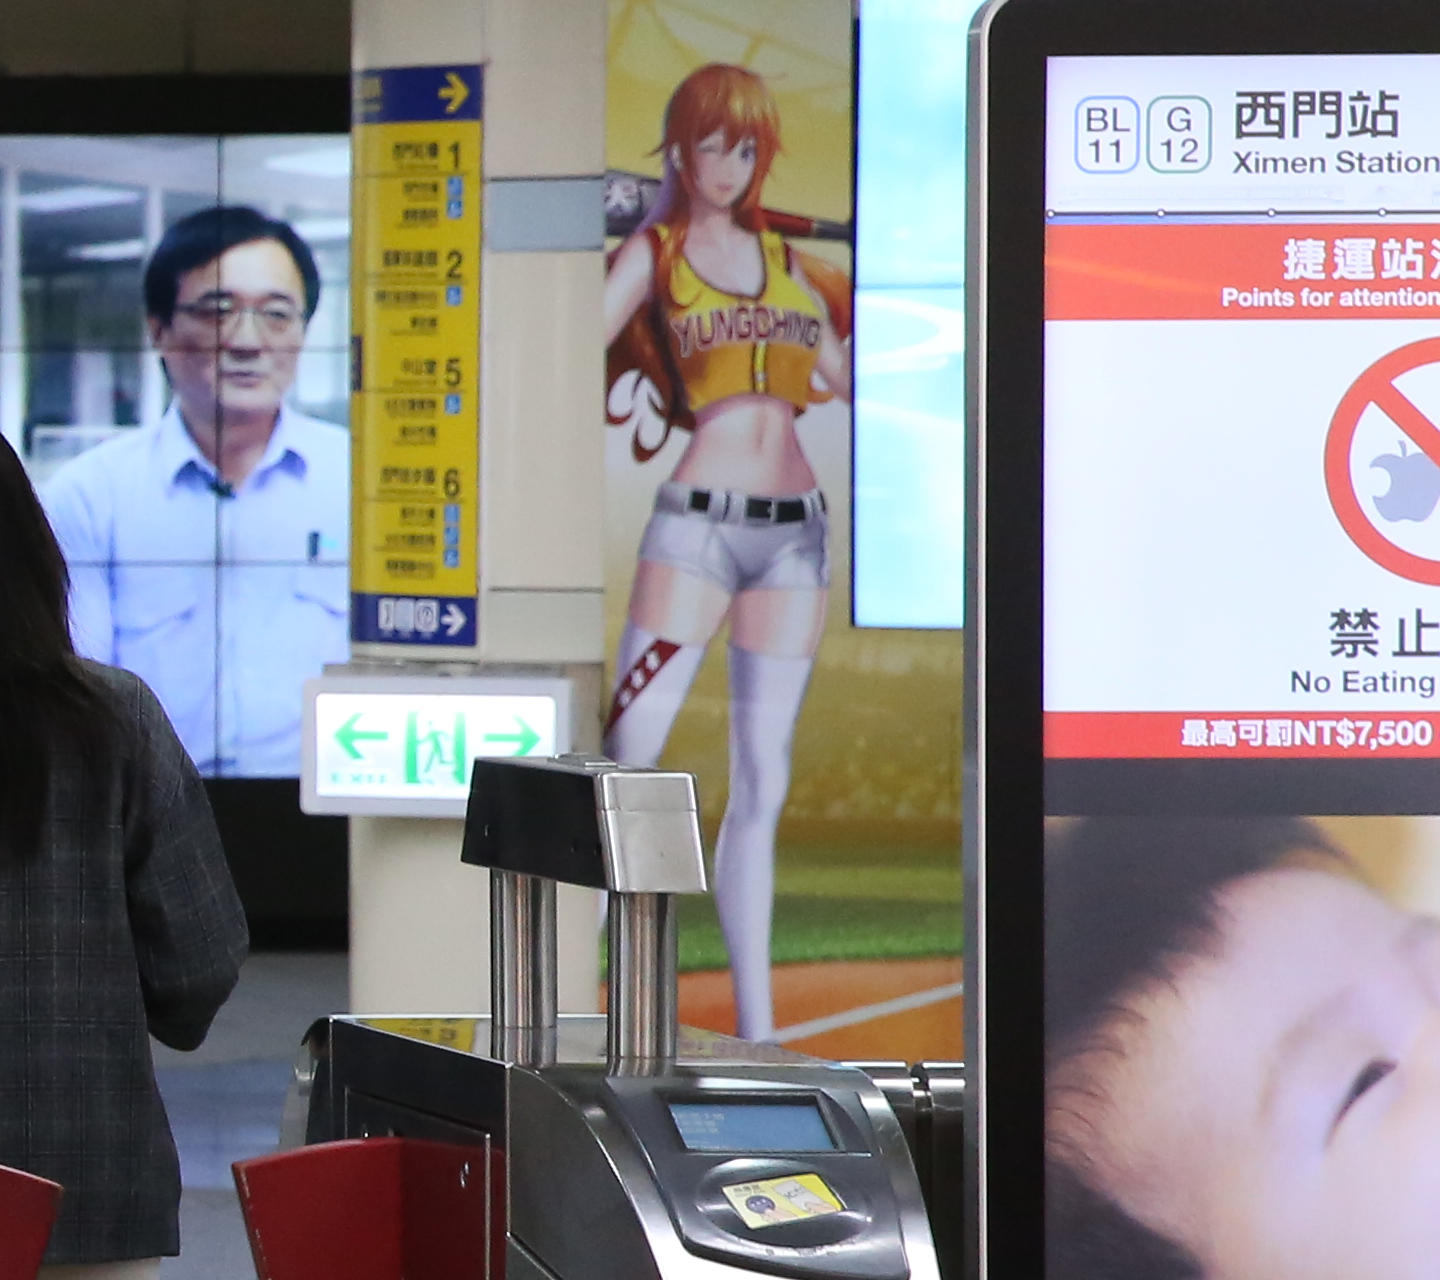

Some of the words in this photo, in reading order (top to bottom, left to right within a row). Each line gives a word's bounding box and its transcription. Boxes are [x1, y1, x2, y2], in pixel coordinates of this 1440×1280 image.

[1086, 107, 1130, 132] BL
[1166, 107, 1192, 132] G
[1234, 90, 1400, 140] 西門站
[1089, 140, 1123, 163] 11
[1160, 139, 1199, 164] 12
[1233, 151, 1327, 174] Ximen
[1335, 150, 1440, 174] Station
[446, 251, 463, 278] 2
[1283, 237, 1440, 282] 捷運站
[1221, 287, 1295, 307] Points
[1300, 287, 1334, 307] for
[1339, 287, 1440, 307] attention
[444, 358, 461, 387] 5
[443, 469, 460, 497] 6
[1329, 608, 1440, 658] 禁止
[1290, 671, 1331, 694] No
[1342, 670, 1436, 698] Eating
